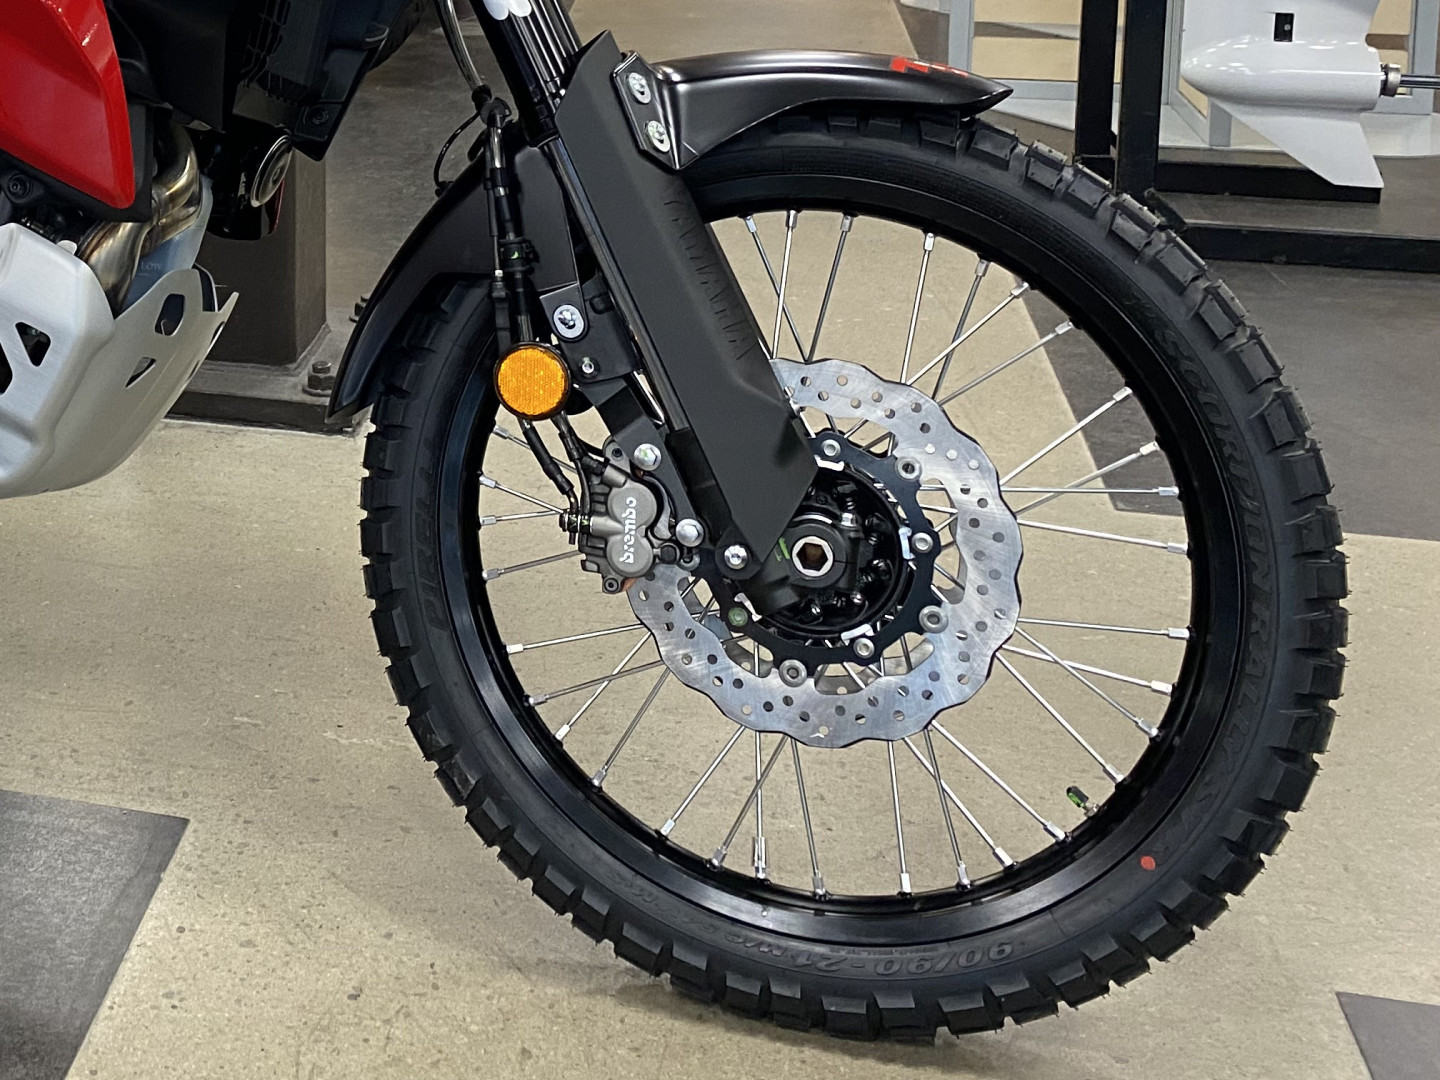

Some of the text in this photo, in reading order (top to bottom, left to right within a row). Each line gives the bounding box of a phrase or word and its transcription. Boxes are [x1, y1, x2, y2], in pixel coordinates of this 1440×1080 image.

[617, 496, 638, 564] brembo
[1155, 324, 1273, 598] SCORPION
[1220, 600, 1272, 774] RALLY
